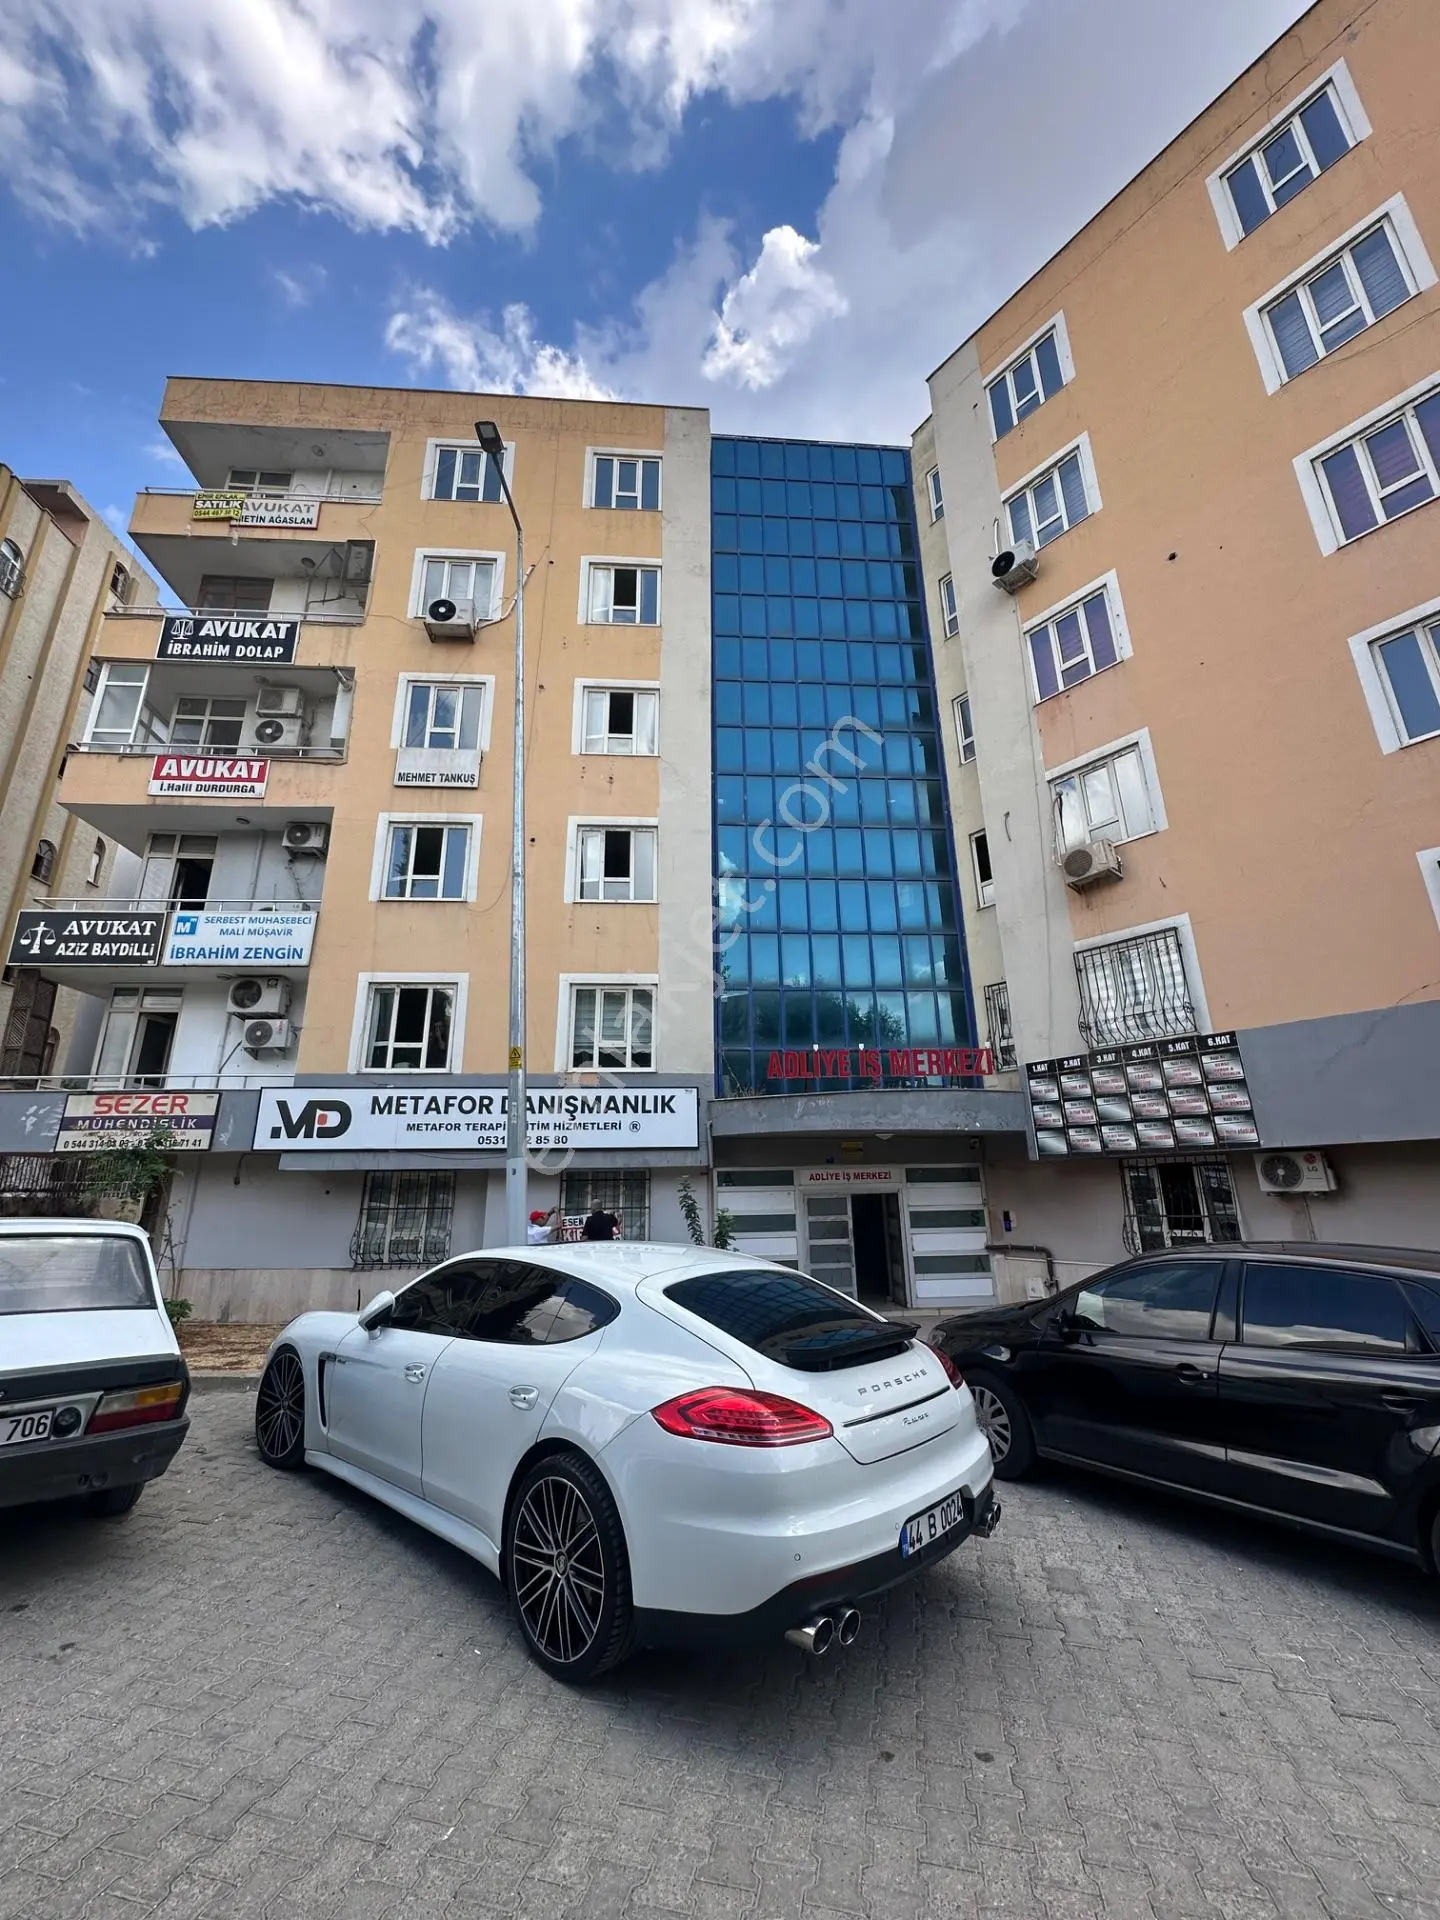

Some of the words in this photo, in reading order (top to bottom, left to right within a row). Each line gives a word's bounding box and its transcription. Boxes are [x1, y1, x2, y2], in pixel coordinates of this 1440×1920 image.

[195, 500, 243, 509] SATILIK
[243, 502, 315, 513] AVUKAT
[268, 514, 313, 525] AĞASLAN
[199, 620, 291, 639] AVUKAT
[167, 640, 230, 656] İBRAHİM
[235, 645, 284, 658] DOLAP
[160, 759, 265, 778] AVUKAT
[398, 772, 437, 782] MEHMET
[439, 773, 476, 785] TANKUŞ
[195, 784, 256, 794] DURDURGA
[204, 916, 246, 924] SERBEST
[248, 916, 311, 925] MUHASEBECİ
[62, 920, 156, 936] AVUKAT
[170, 944, 240, 959] İBRAHİM
[242, 945, 304, 960] ZENGİN
[1168, 1041, 1190, 1052] 5.KAT
[1207, 1035, 1231, 1047] 6.KAT
[1096, 1052, 1116, 1063] 3.KAT
[1131, 1047, 1152, 1058] 4.KAT
[767, 1044, 850, 1079] ADLİYE
[858, 1043, 882, 1085] İŞ
[1063, 1058, 1081, 1068] 2.KAT
[93, 1095, 189, 1114] SEZER
[370, 1095, 494, 1115] METAFOR
[77, 1116, 197, 1129] MÜHENDİSLİK
[406, 1122, 461, 1131] METAFOR
[465, 1121, 506, 1131] TERAPİ
[71, 1140, 87, 1149] 544
[477, 1135, 506, 1145] 0531
[535, 1136, 550, 1145] 85
[554, 1136, 569, 1145] 80
[809, 1170, 840, 1181] ADLİYE
[842, 1170, 851, 1182] İŞ
[853, 1170, 891, 1180] MERKEZİ
[562, 1217, 584, 1227] ESEN
[857, 1368, 928, 1396] PORSCHE
[6, 1414, 49, 1442] 706
[909, 1520, 923, 1551] 44
[928, 1512, 937, 1540] B
[940, 1494, 964, 1531] 0024
